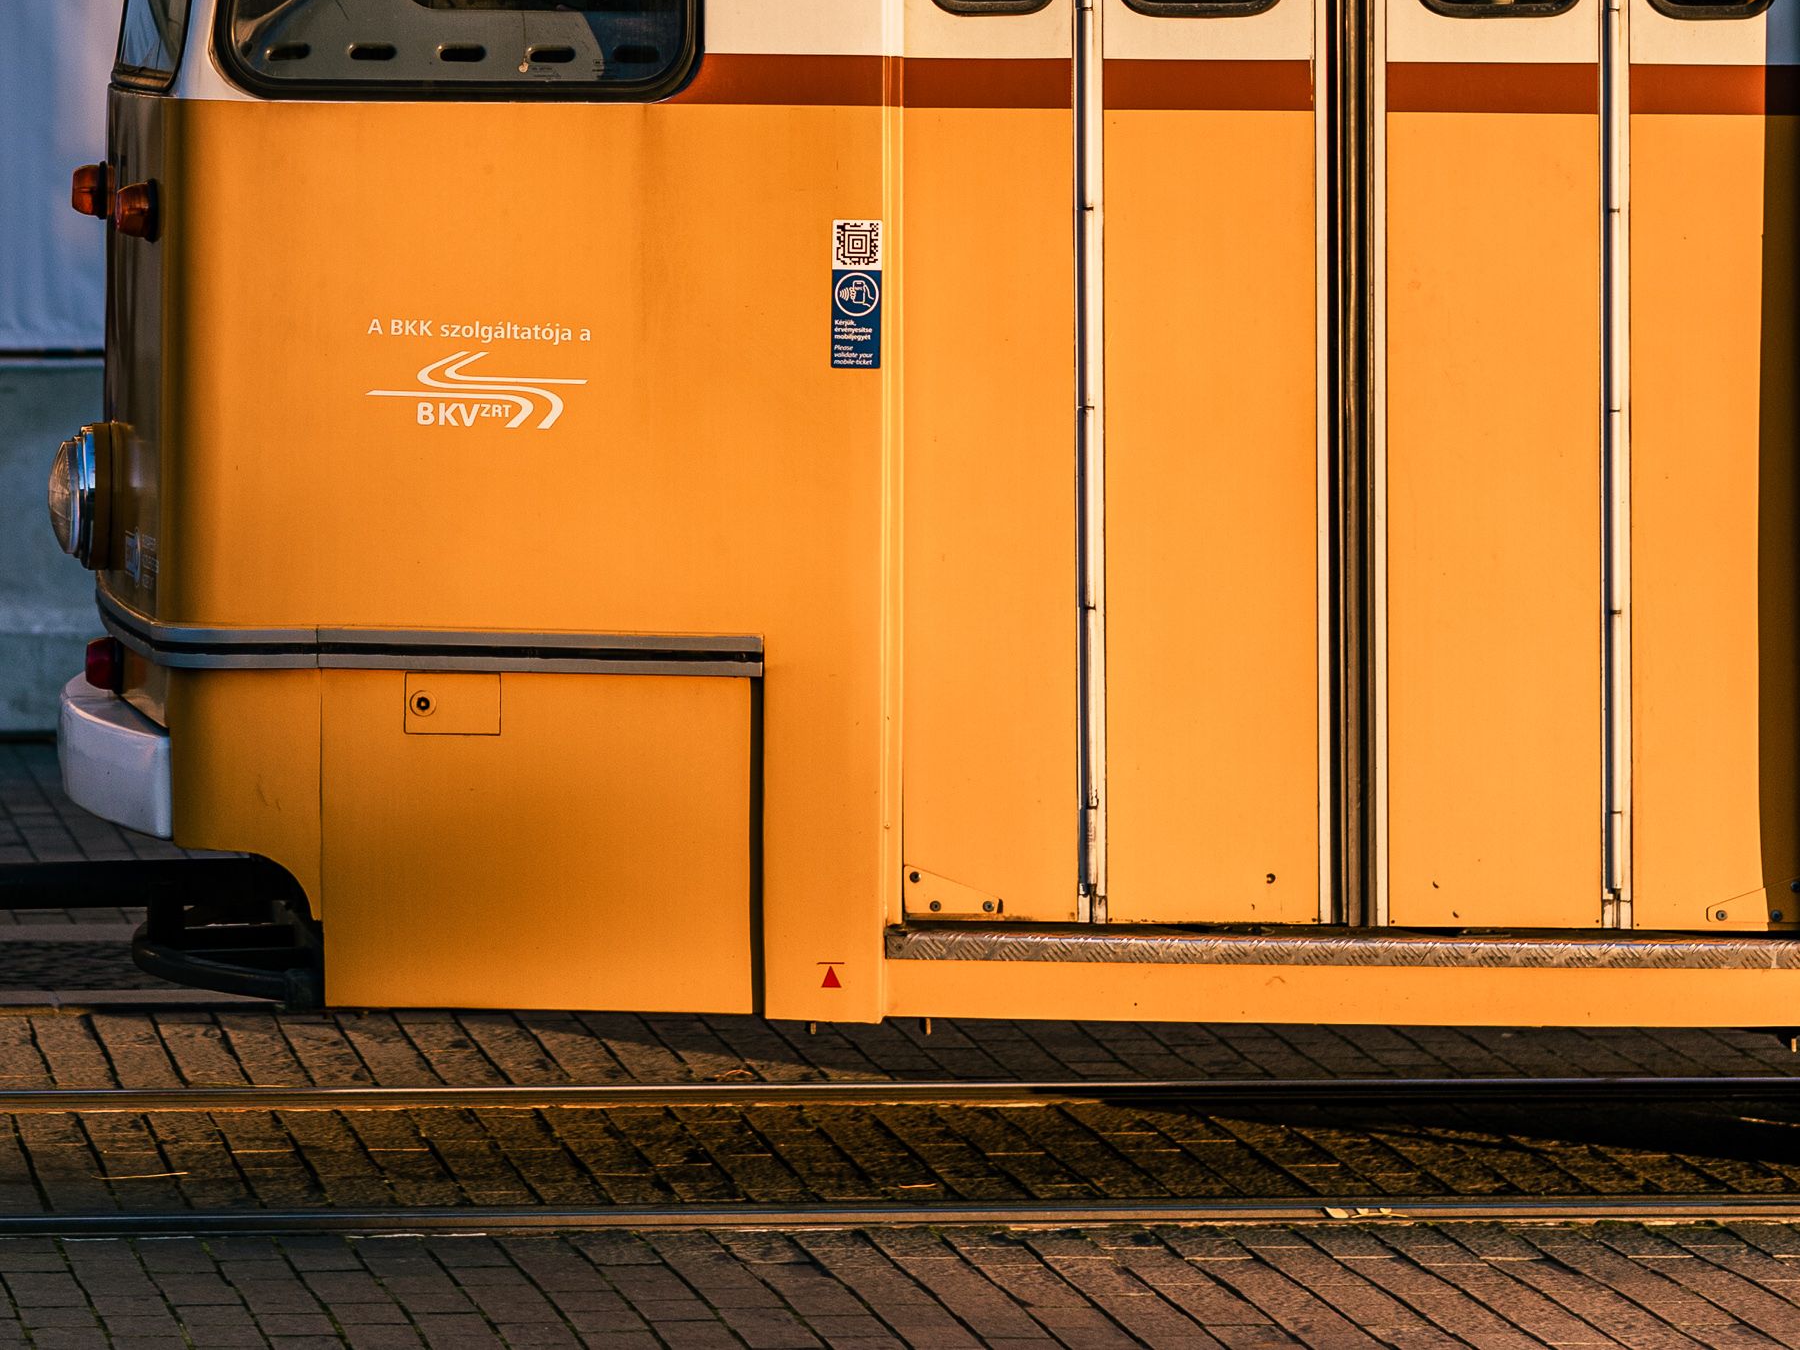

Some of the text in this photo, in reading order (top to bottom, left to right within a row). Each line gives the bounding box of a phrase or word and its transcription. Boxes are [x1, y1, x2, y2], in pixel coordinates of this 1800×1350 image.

[368, 319, 590, 344] A BKK szolgáltatója a
[418, 403, 511, 426] BKV ZRT
